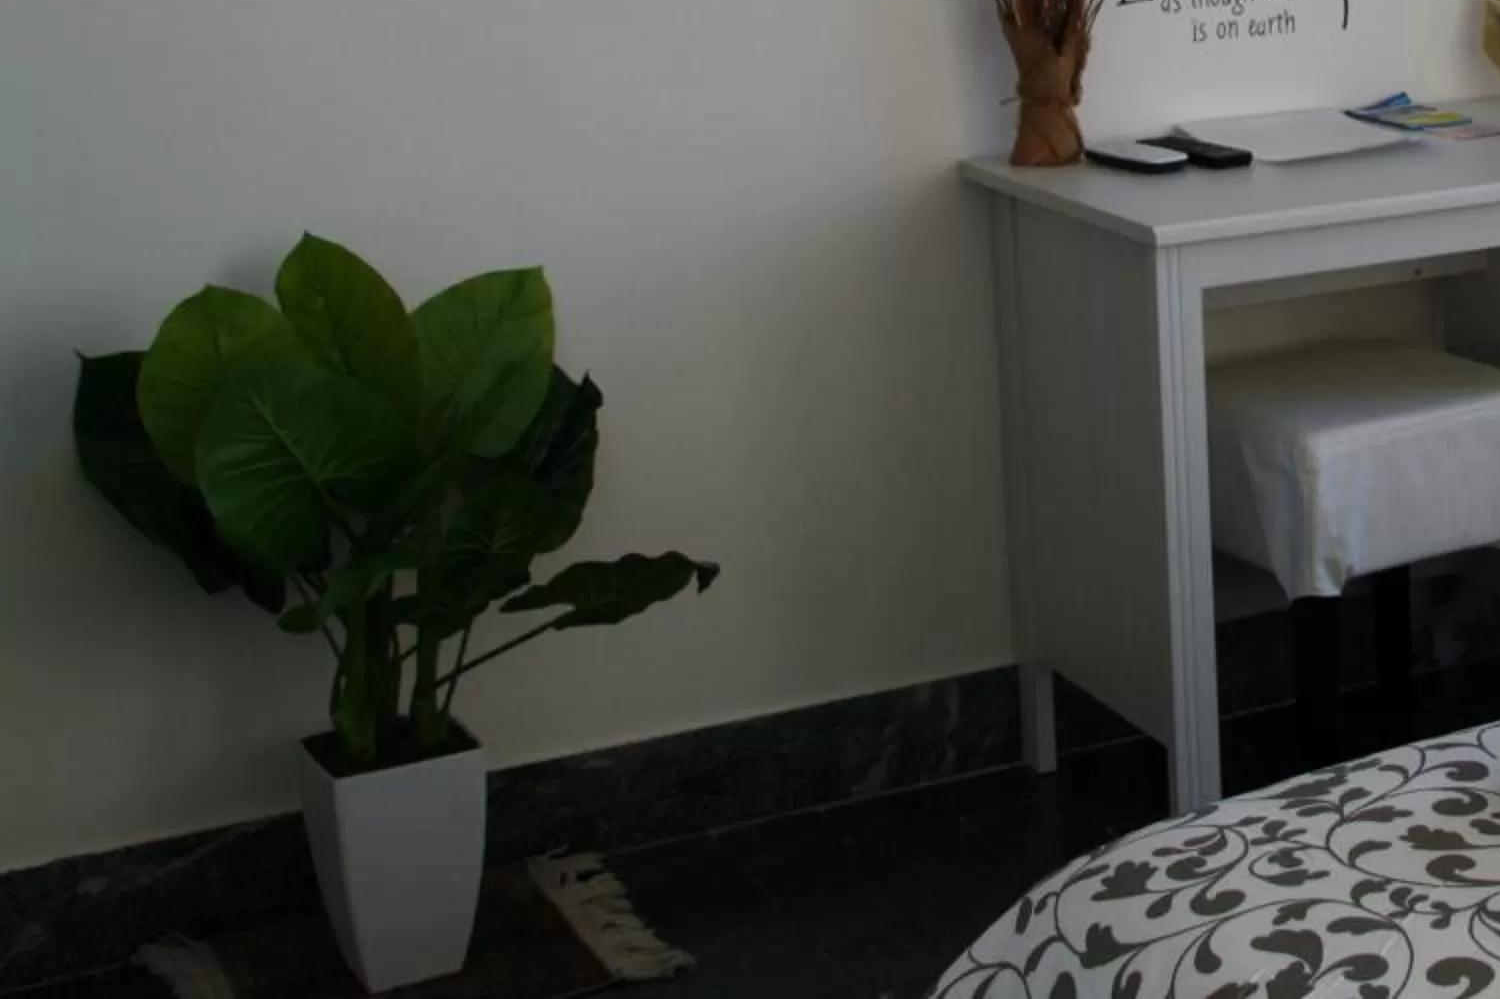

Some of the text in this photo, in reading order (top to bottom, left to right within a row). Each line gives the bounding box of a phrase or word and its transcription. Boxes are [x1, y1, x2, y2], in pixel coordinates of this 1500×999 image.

[1191, 9, 1296, 43] is on earth
